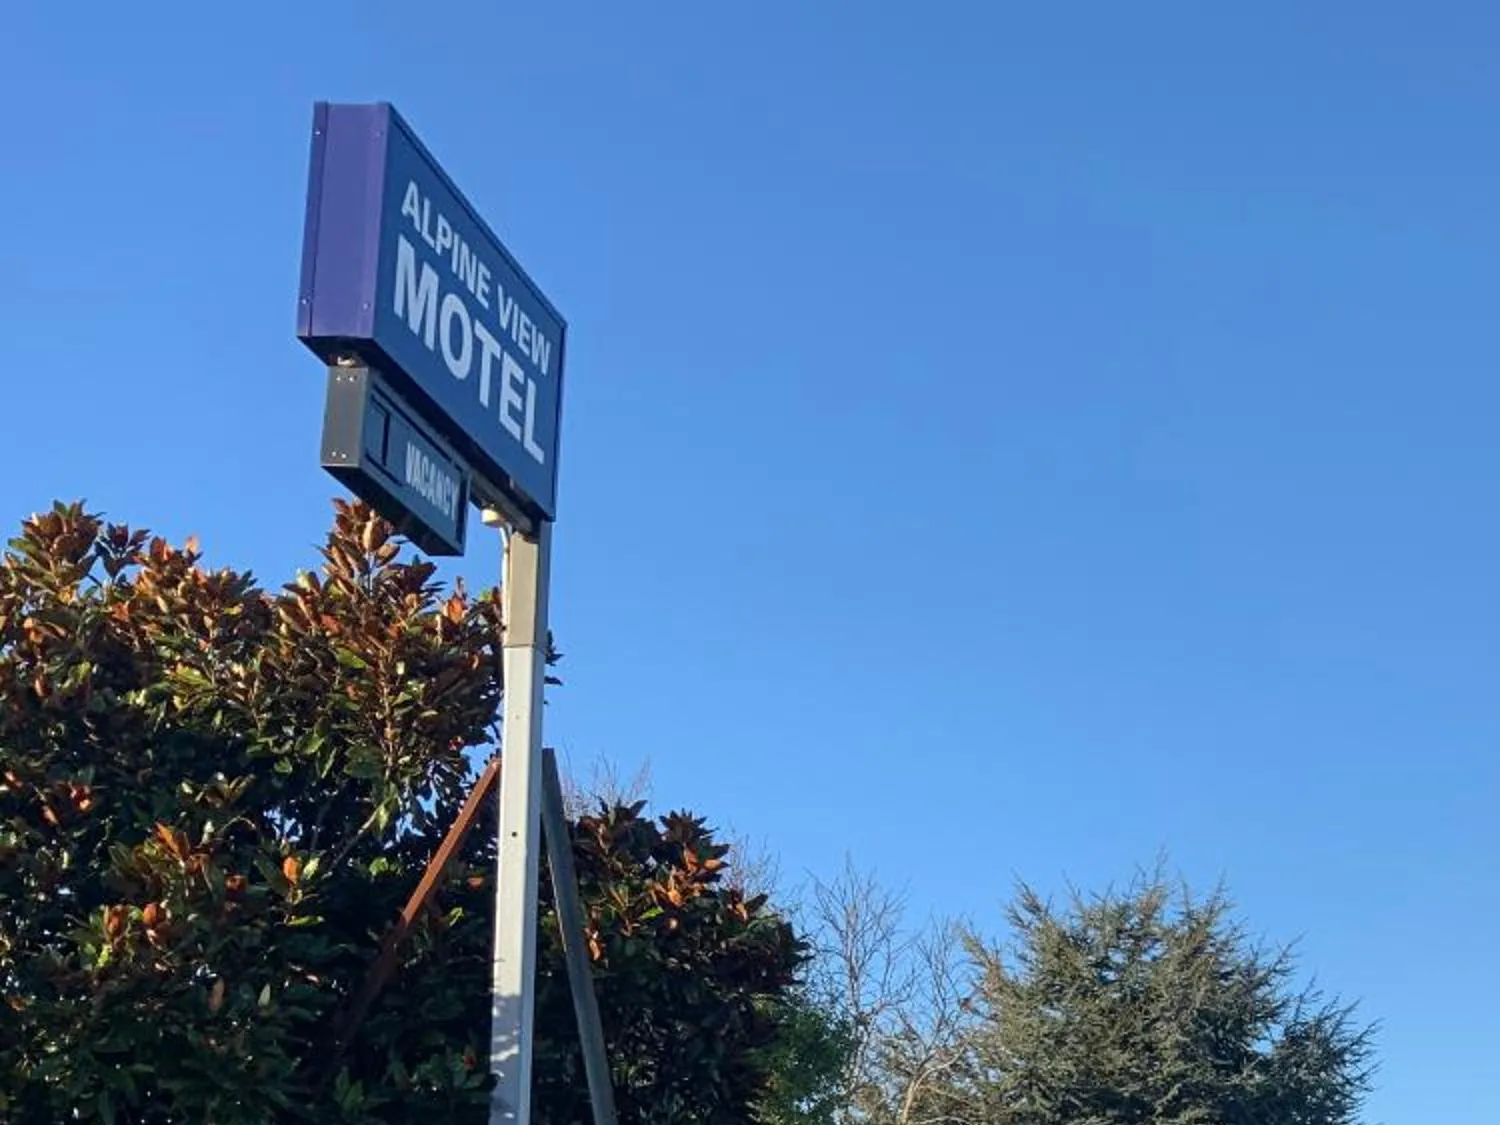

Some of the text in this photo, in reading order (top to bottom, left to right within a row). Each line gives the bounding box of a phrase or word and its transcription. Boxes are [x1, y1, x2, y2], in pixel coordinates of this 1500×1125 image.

[393, 235, 545, 464] MOTEL
[401, 181, 551, 375] ALPINE VIEW
[405, 440, 459, 521] VACANCY
